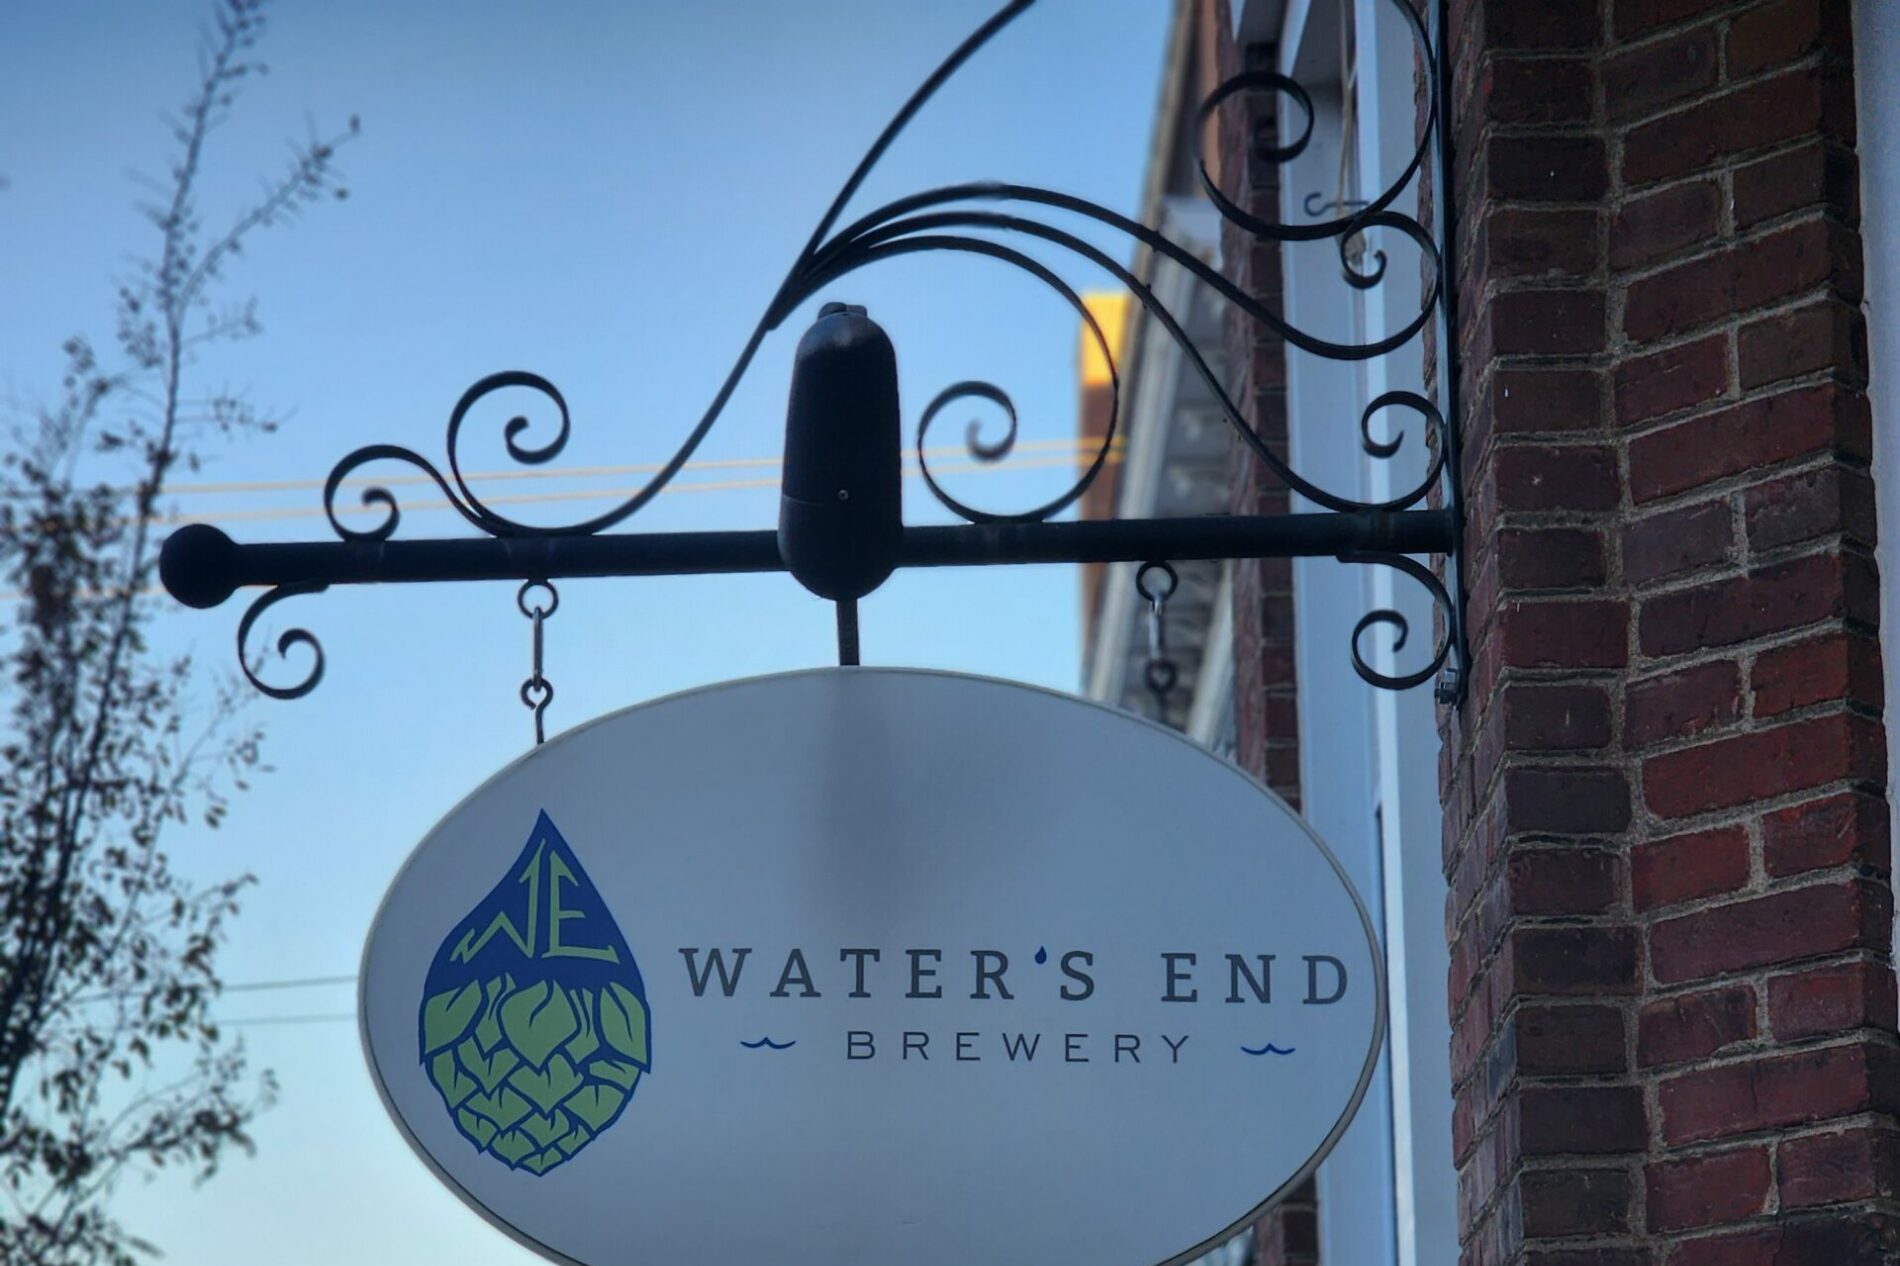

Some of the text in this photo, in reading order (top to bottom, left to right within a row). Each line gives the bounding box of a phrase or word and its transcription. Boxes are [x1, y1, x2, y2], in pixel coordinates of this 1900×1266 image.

[678, 946, 1348, 1005] WATER'S END
[847, 1030, 1190, 1064] BREWERY
